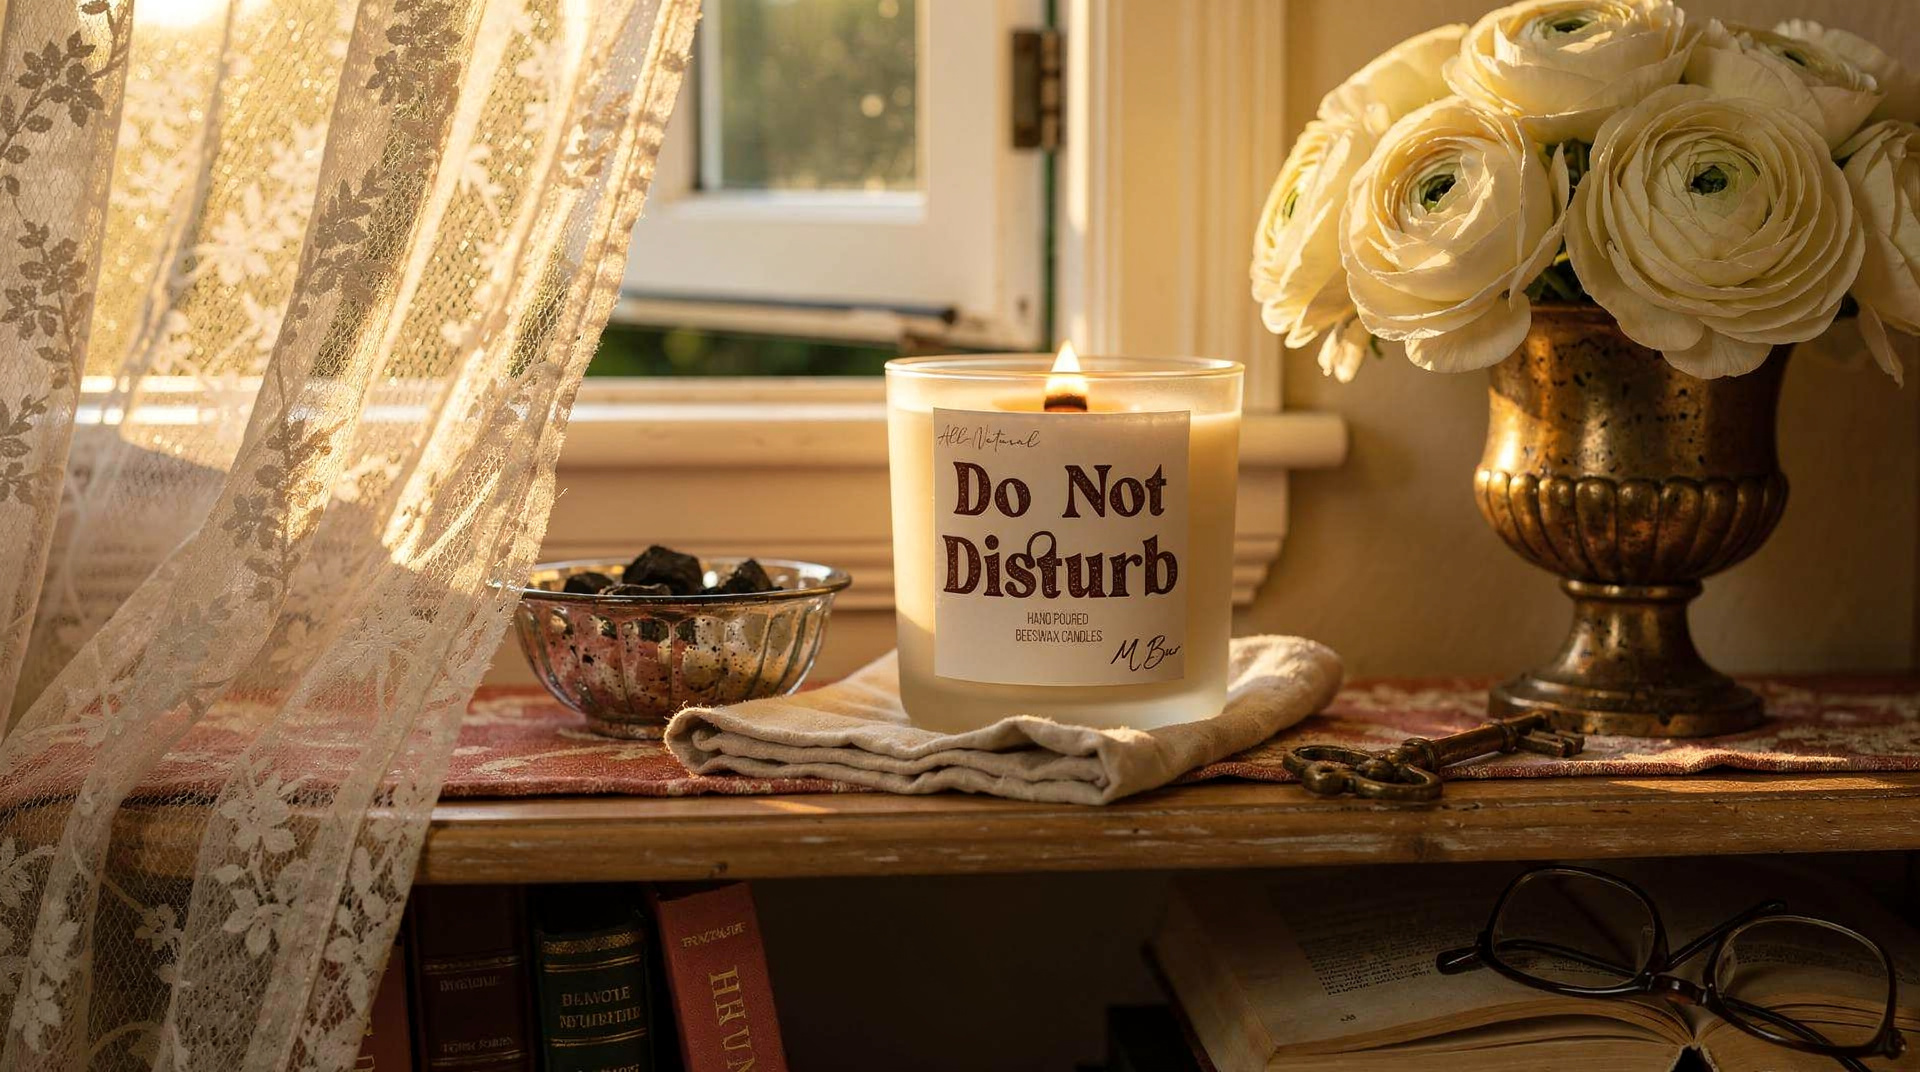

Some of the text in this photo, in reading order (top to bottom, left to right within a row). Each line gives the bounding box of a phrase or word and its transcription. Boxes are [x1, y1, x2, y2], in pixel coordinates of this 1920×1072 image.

[937, 424, 1041, 452] All Natural
[952, 461, 1168, 518] Do Not
[942, 530, 1179, 599] Disturb
[1027, 611, 1089, 626] HAND POURED
[1015, 628, 1103, 643] BEESWAX CANDLES
